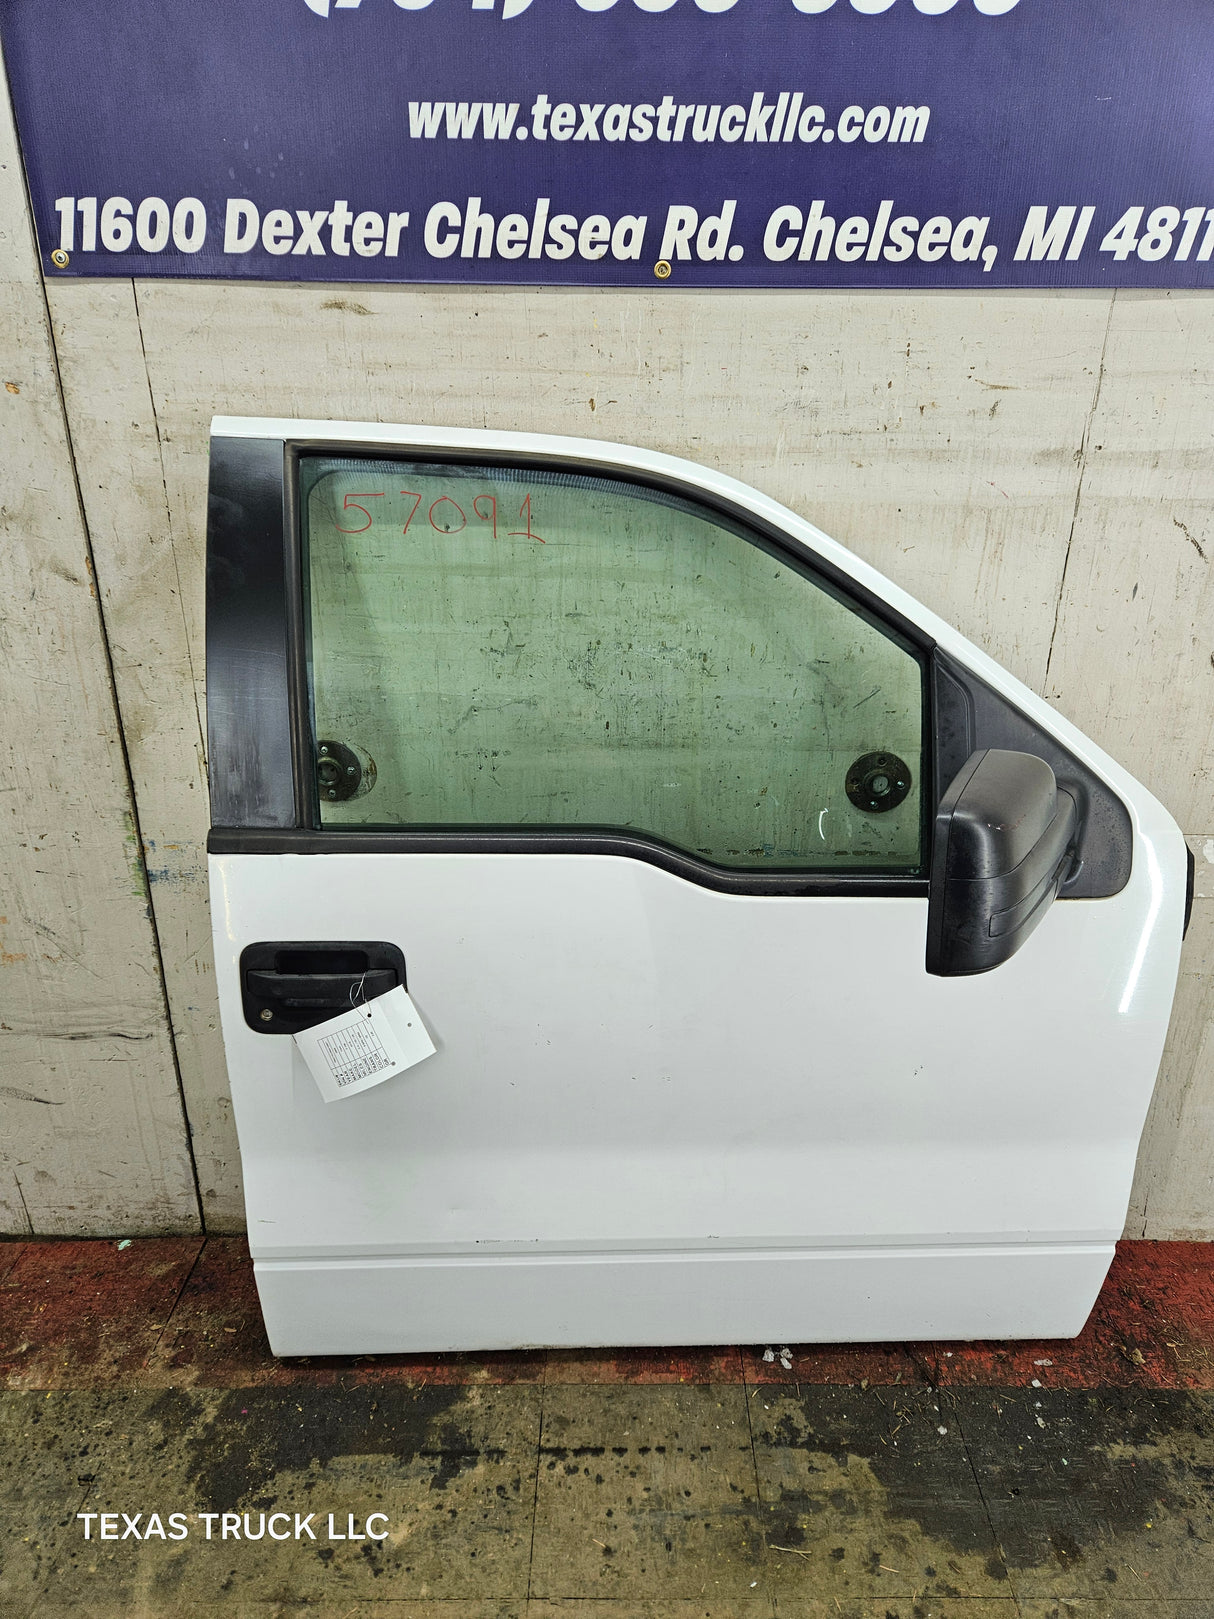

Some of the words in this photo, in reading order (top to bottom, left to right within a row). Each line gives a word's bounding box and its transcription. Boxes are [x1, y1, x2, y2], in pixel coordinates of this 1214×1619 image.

[408, 92, 931, 143] www.texastruckllc.com
[54, 196, 207, 253] 11600
[223, 198, 410, 257] Dexter
[423, 196, 648, 260] Chelsea
[658, 199, 745, 262] Rd.
[763, 199, 998, 272] Chelsea,
[1013, 205, 1096, 261] MI
[335, 490, 546, 544] 57091
